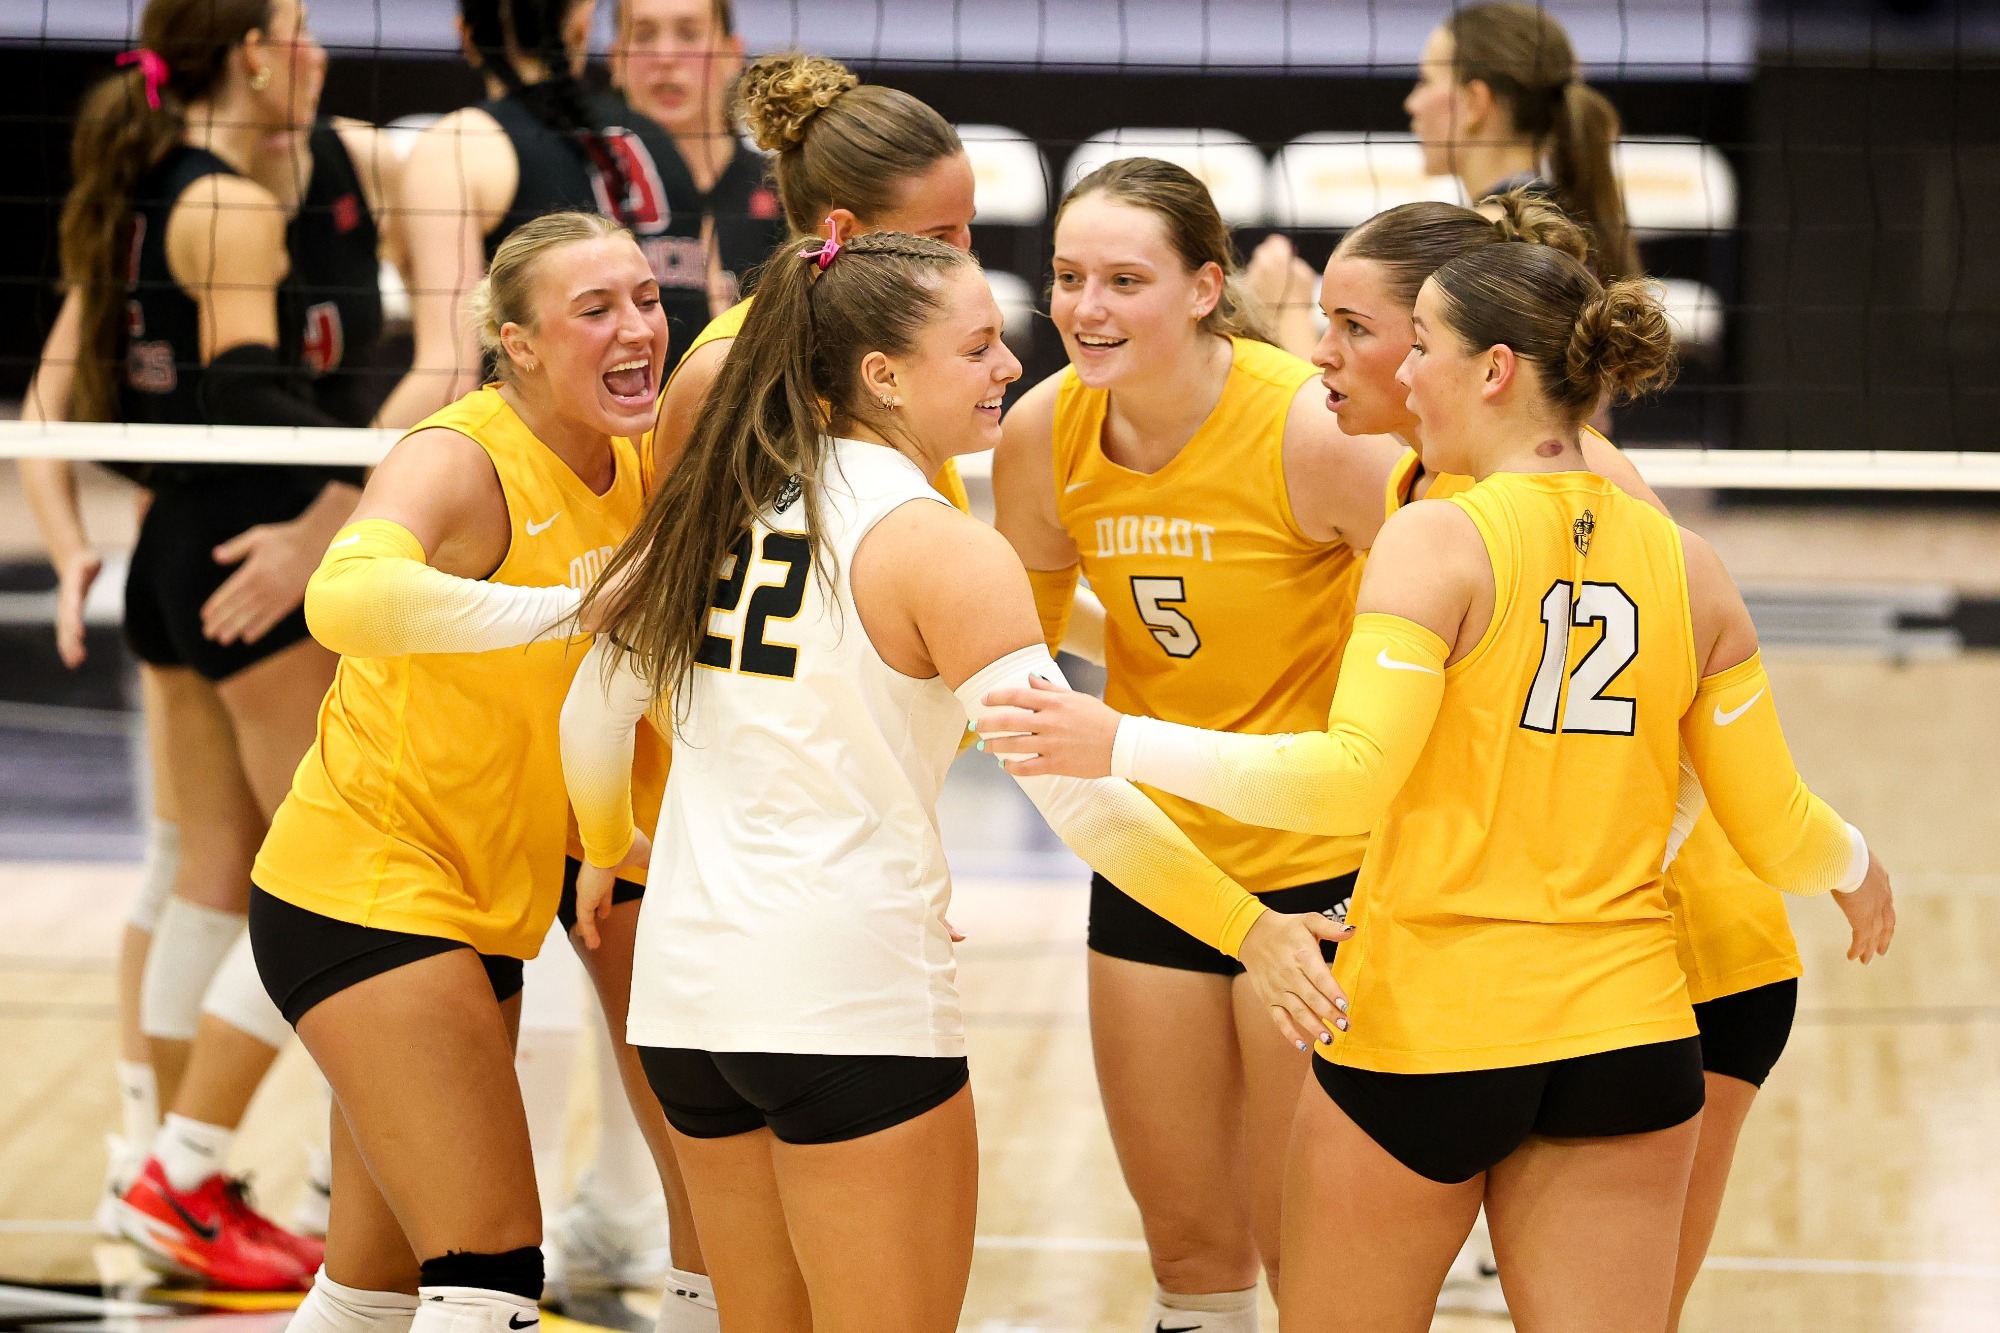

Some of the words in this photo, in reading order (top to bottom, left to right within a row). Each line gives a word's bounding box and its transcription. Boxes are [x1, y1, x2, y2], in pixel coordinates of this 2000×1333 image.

[692, 526, 815, 682] 22
[1129, 575, 1202, 659] 5
[1518, 578, 1639, 737] 12
